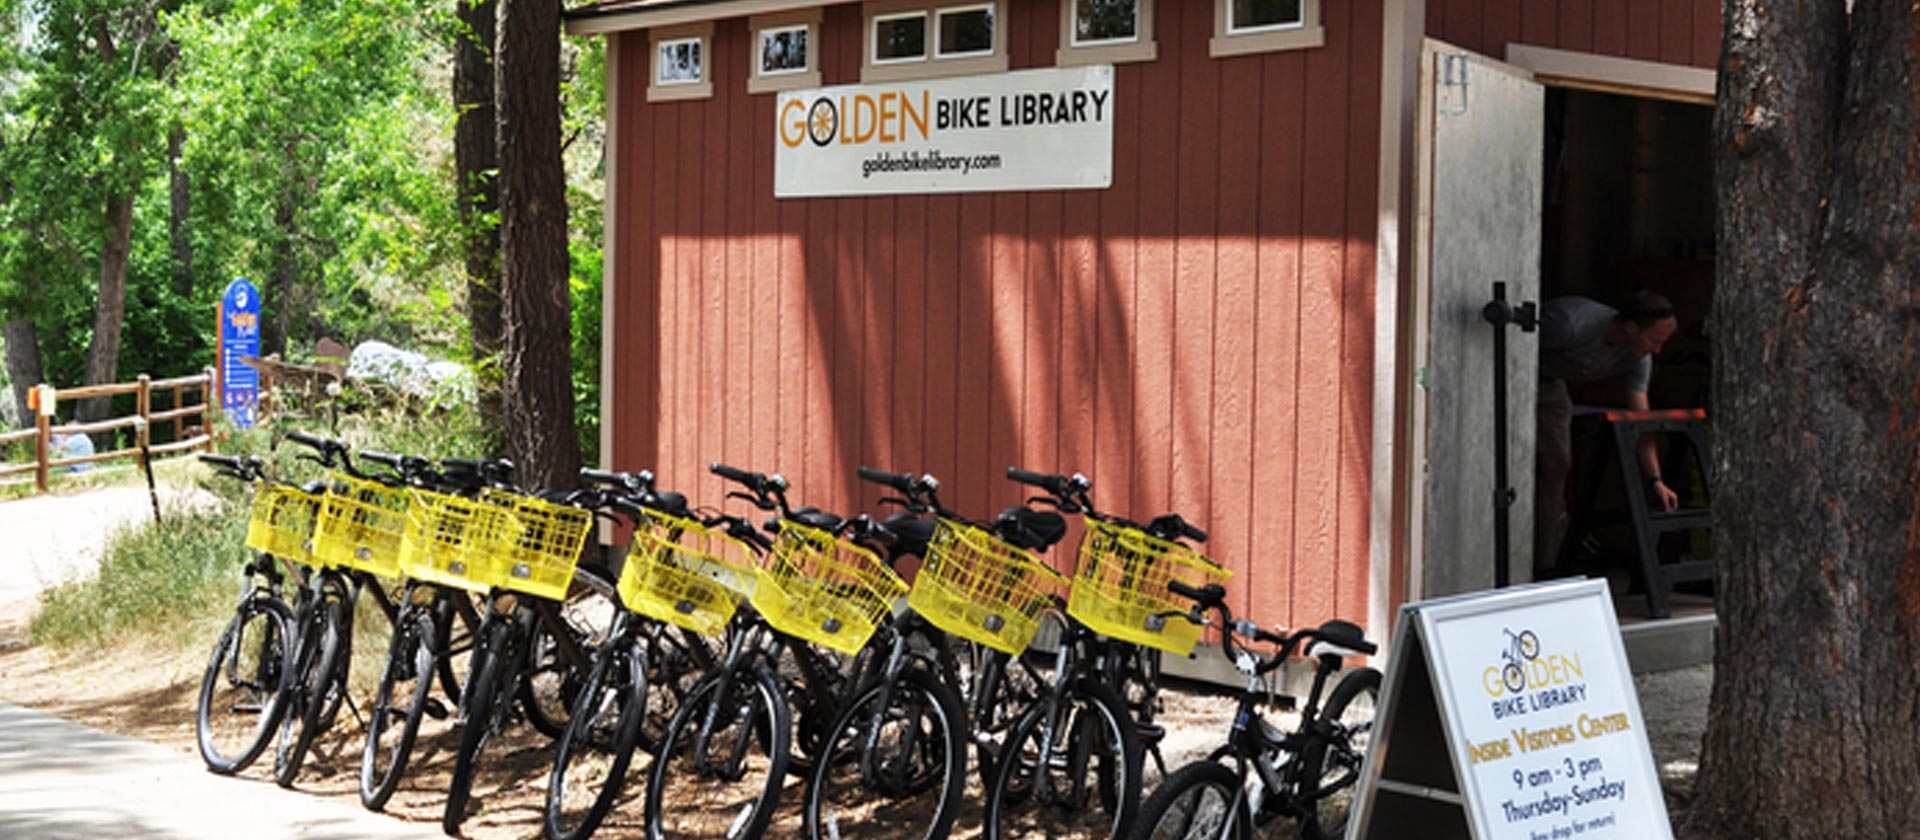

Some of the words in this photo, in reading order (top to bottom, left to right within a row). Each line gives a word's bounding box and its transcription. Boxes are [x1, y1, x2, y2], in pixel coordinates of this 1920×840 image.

[780, 90, 929, 147] GOLDEN
[937, 97, 990, 129] BIKE
[1001, 90, 1109, 125] LIBRARY
[863, 149, 1000, 178] goldenbikelibrary.com
[1483, 653, 1583, 697] GOLDEN
[1492, 697, 1526, 719] BIKE
[1530, 683, 1586, 711] LIBRARY
[1513, 768, 1523, 790] 9
[1528, 769, 1552, 786] am
[1563, 757, 1575, 778] 3
[1579, 757, 1602, 780] pm
[1502, 776, 1626, 822] Thursday-Sunday
